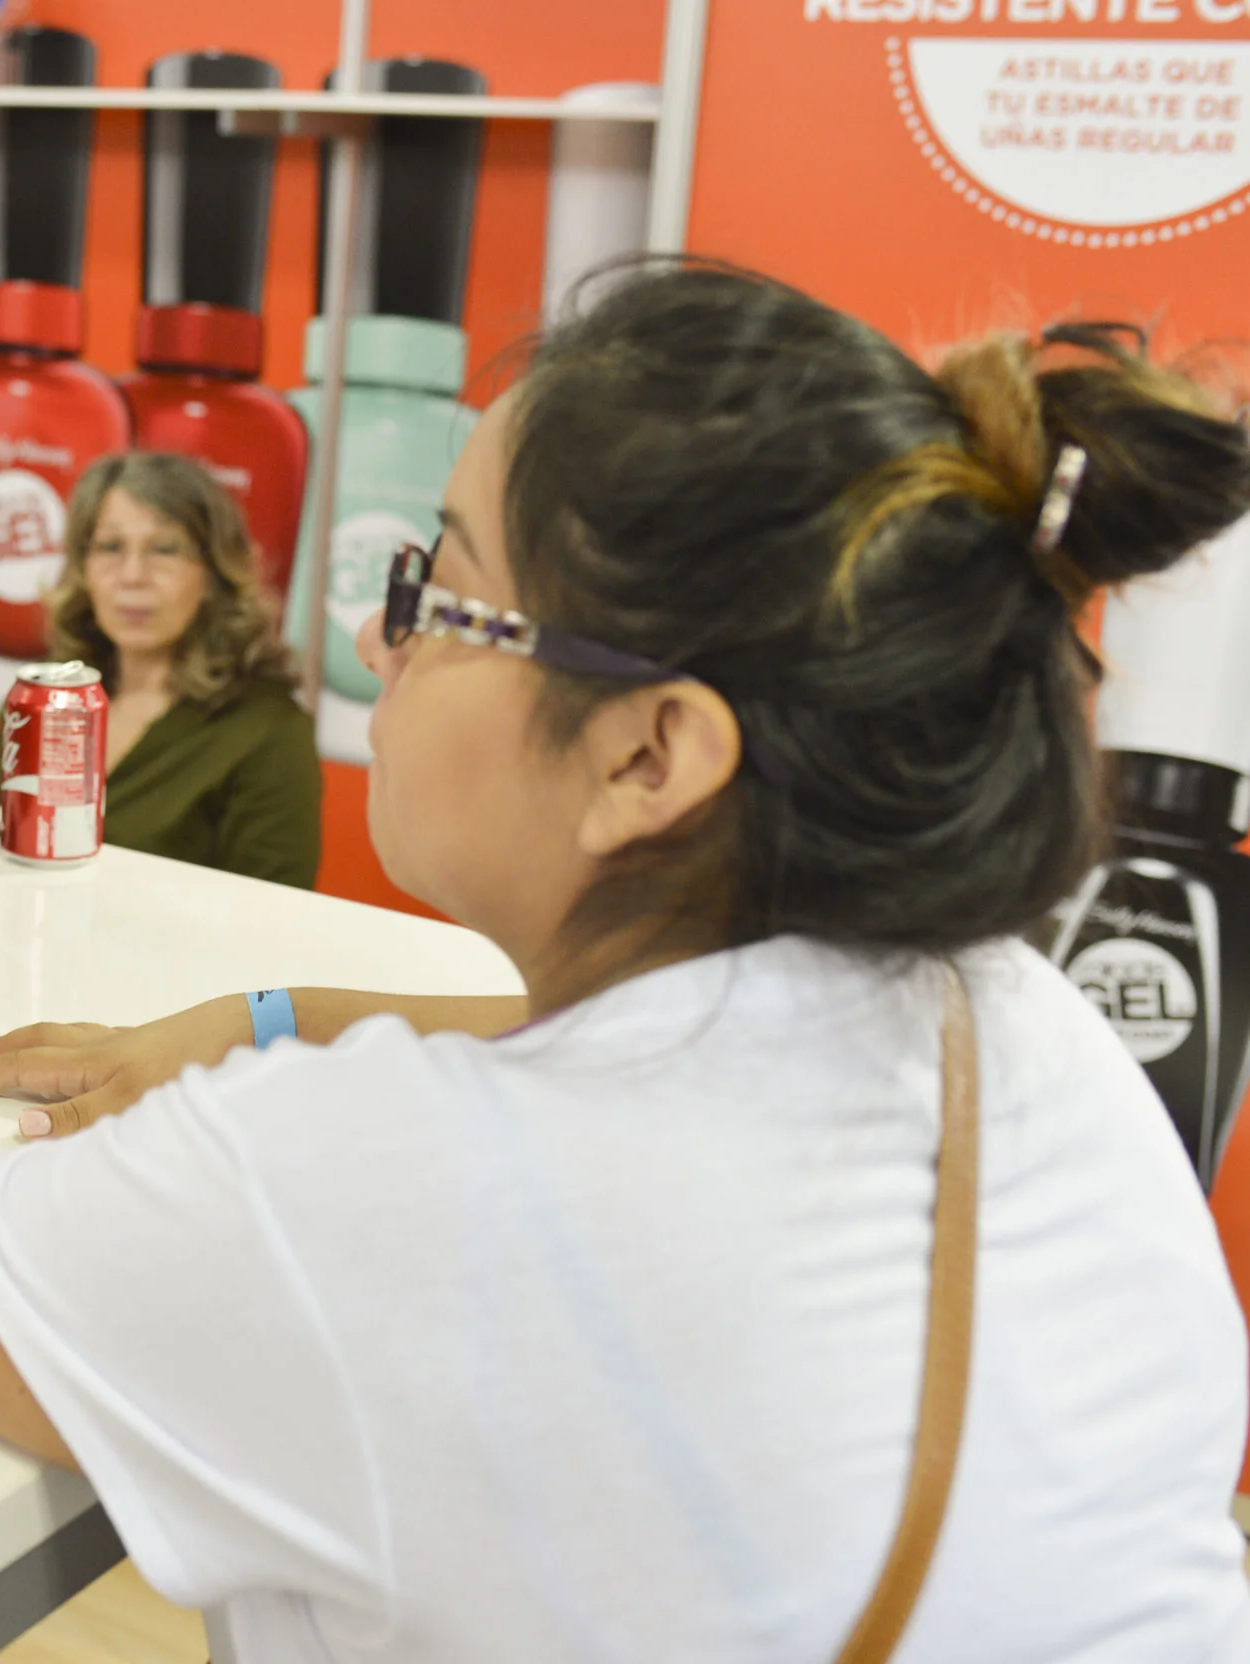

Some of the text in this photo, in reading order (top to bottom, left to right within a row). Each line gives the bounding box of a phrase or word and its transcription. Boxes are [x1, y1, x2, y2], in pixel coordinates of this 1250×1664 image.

[998, 57, 1235, 84] ASTILLAS QUE
[986, 89, 1242, 121] TU ESMALTE DE
[980, 121, 1236, 155] UÑAS REGULAR
[1080, 981, 1194, 1020] GEL
